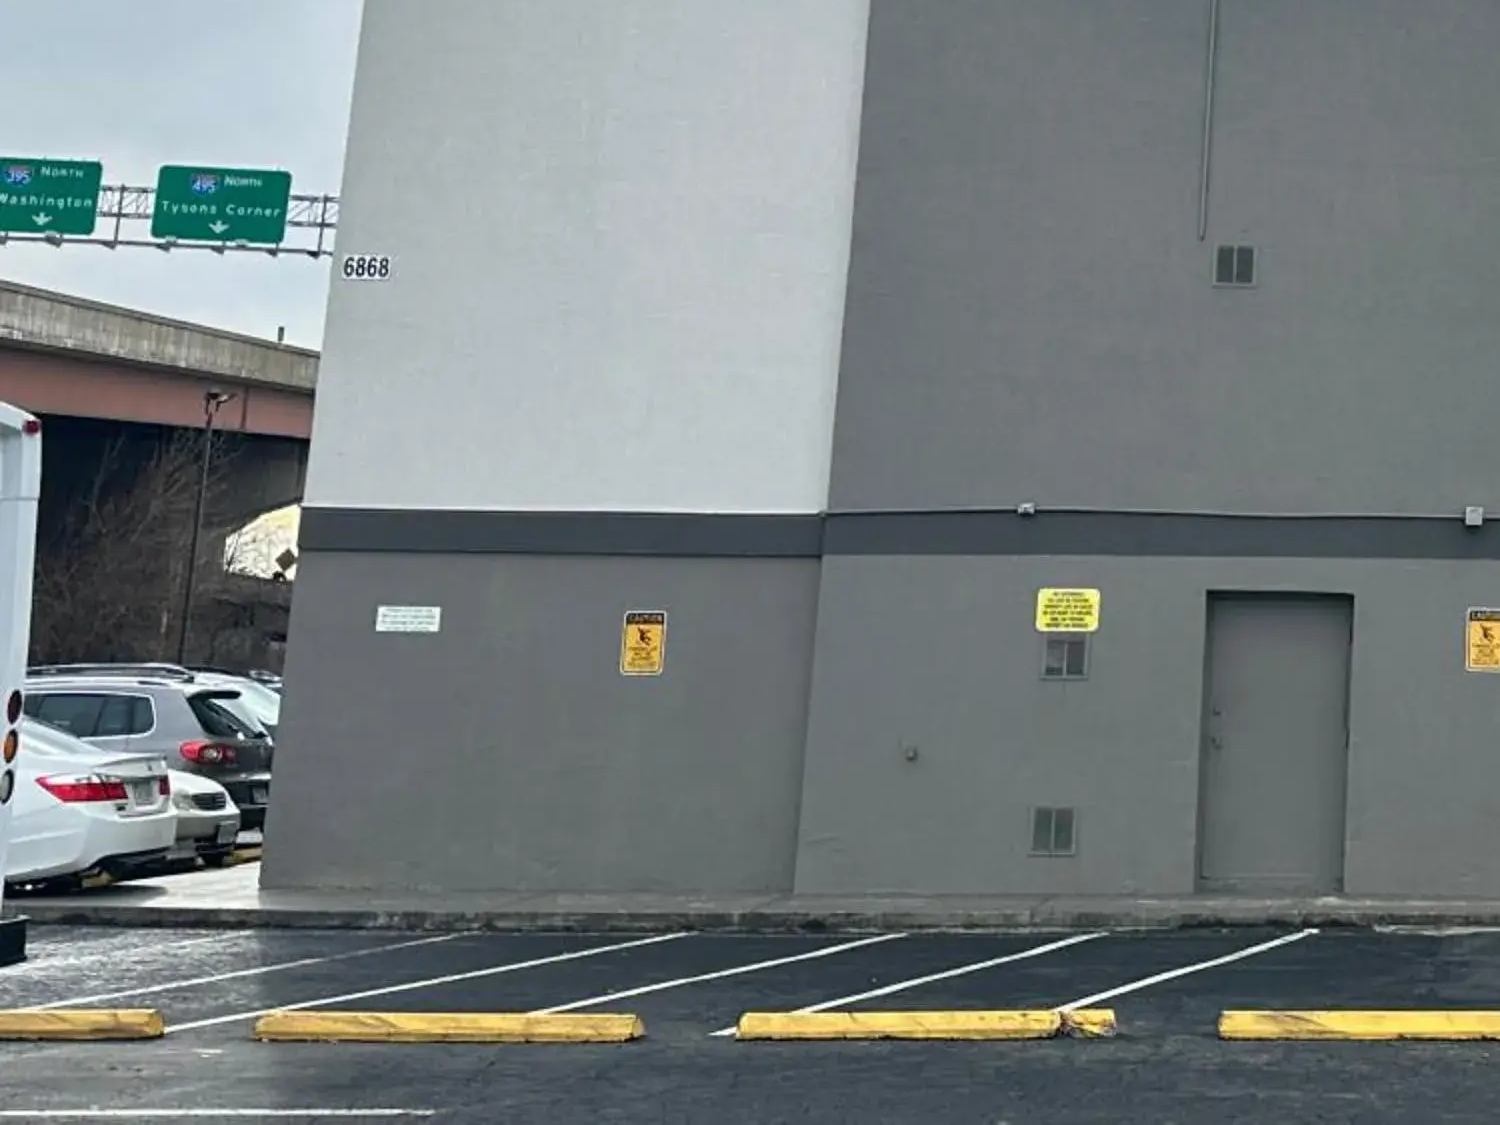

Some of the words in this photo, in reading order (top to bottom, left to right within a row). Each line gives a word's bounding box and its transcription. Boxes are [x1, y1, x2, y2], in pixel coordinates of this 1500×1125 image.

[192, 178, 216, 195] 495
[0, 192, 93, 210] Washington
[161, 200, 218, 216] Tysons
[225, 203, 282, 218] Corner
[343, 256, 390, 279] 6868
